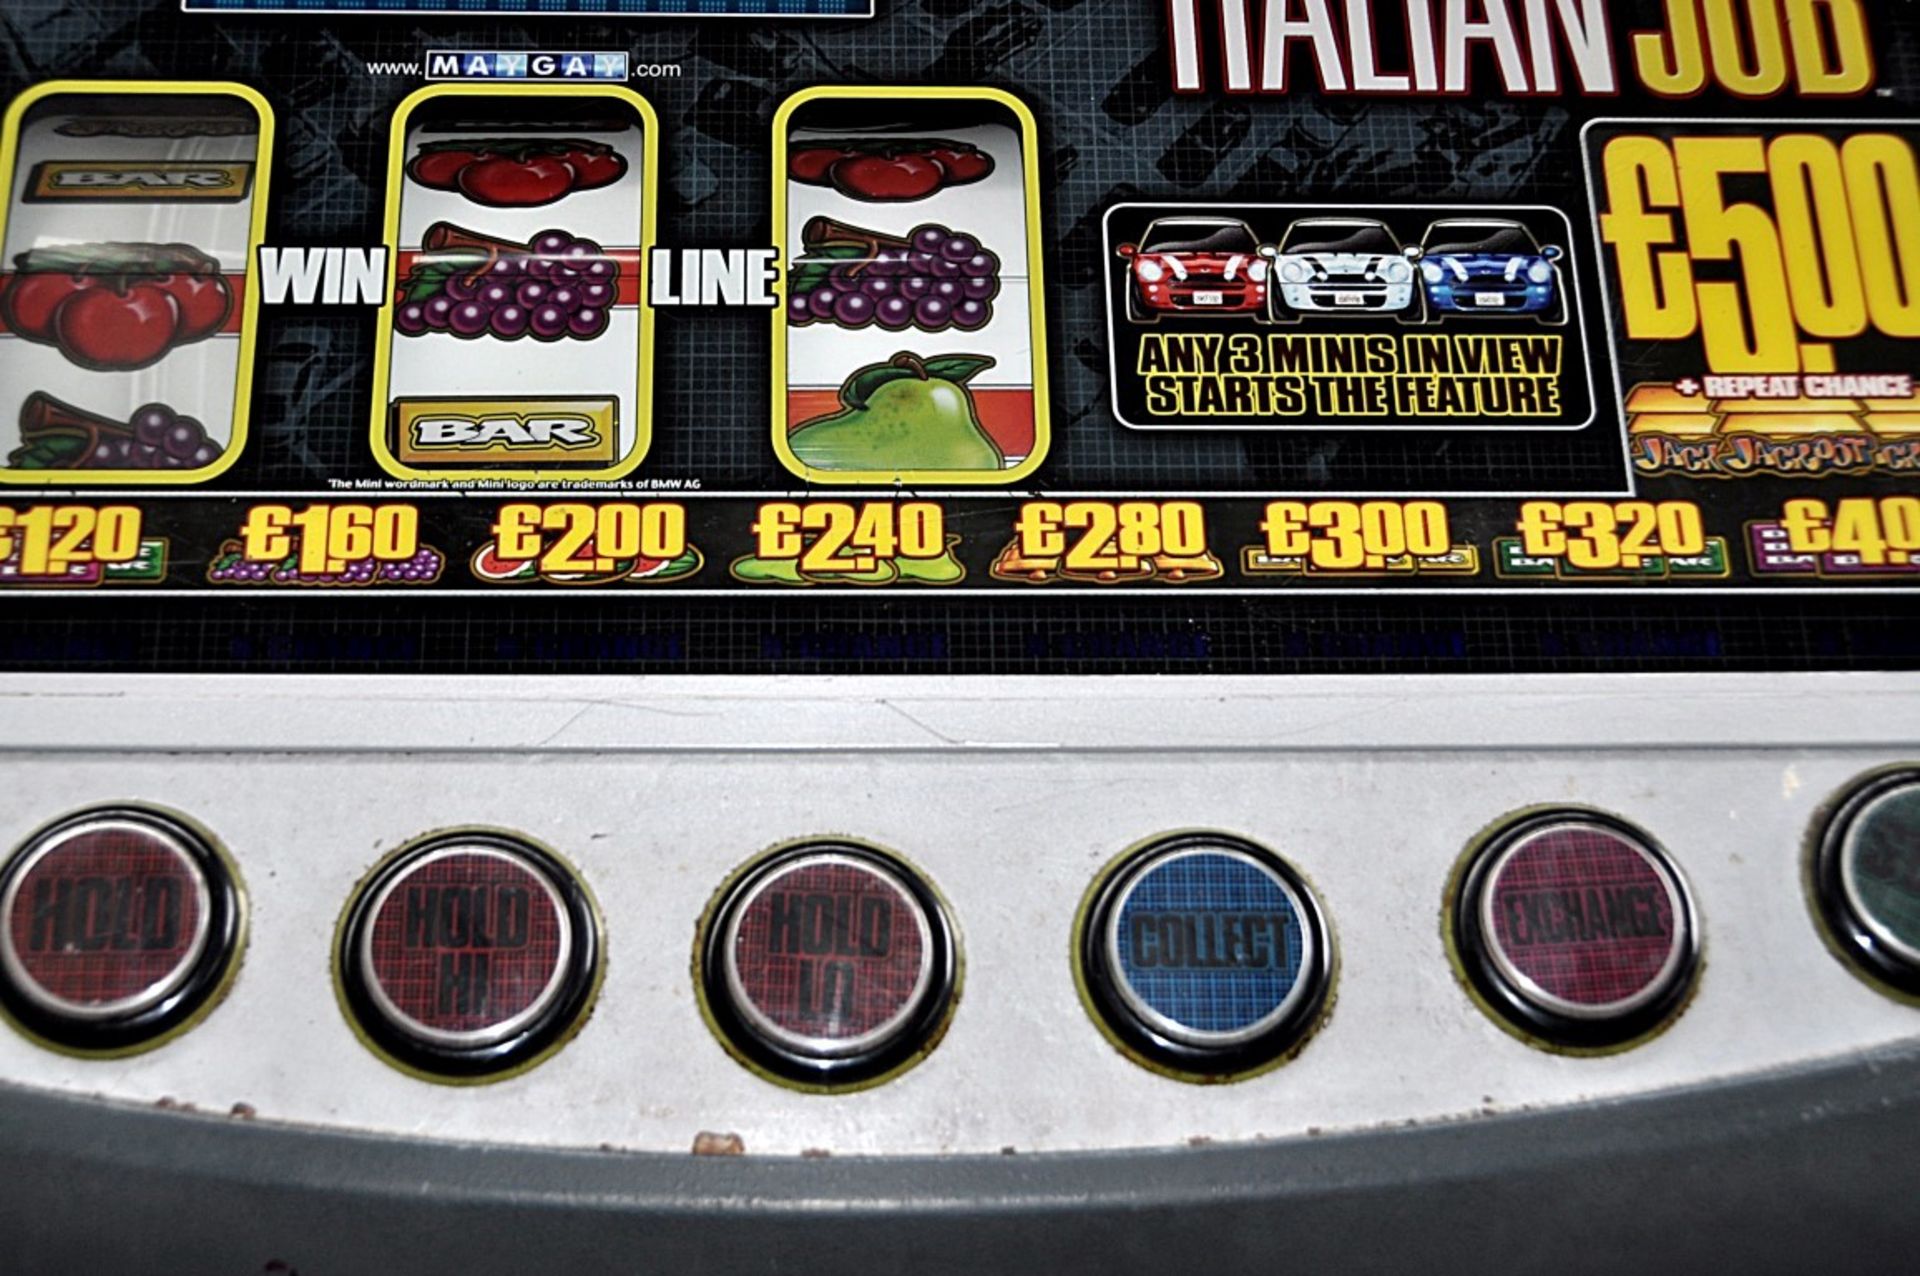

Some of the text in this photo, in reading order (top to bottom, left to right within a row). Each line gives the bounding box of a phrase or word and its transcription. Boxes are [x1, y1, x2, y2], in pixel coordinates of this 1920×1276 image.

[53, 170, 231, 187] BAR
[259, 246, 779, 306] WIN LINE
[1137, 334, 1562, 376] ANY 3 MINIS IN VIEW
[1146, 374, 1562, 416] STARTS THE FEATURE
[1704, 375, 1799, 397] REPEAT
[1804, 375, 1912, 397] CHANCE
[418, 417, 597, 444] BAR
[384, 478, 449, 489] wordmark
[451, 478, 475, 489] and
[507, 478, 535, 491] logo
[537, 479, 559, 489] are
[562, 478, 634, 489] trademarks
[636, 478, 649, 489] of
[650, 478, 682, 489] BMW
[684, 478, 701, 489] AG
[29, 875, 182, 950] HOLD
[406, 885, 529, 948] HOLD
[768, 892, 892, 956] HOLD
[1503, 884, 1666, 946] EXCHANGE
[1130, 913, 1290, 969] COLLECT
[438, 953, 489, 1015] HI
